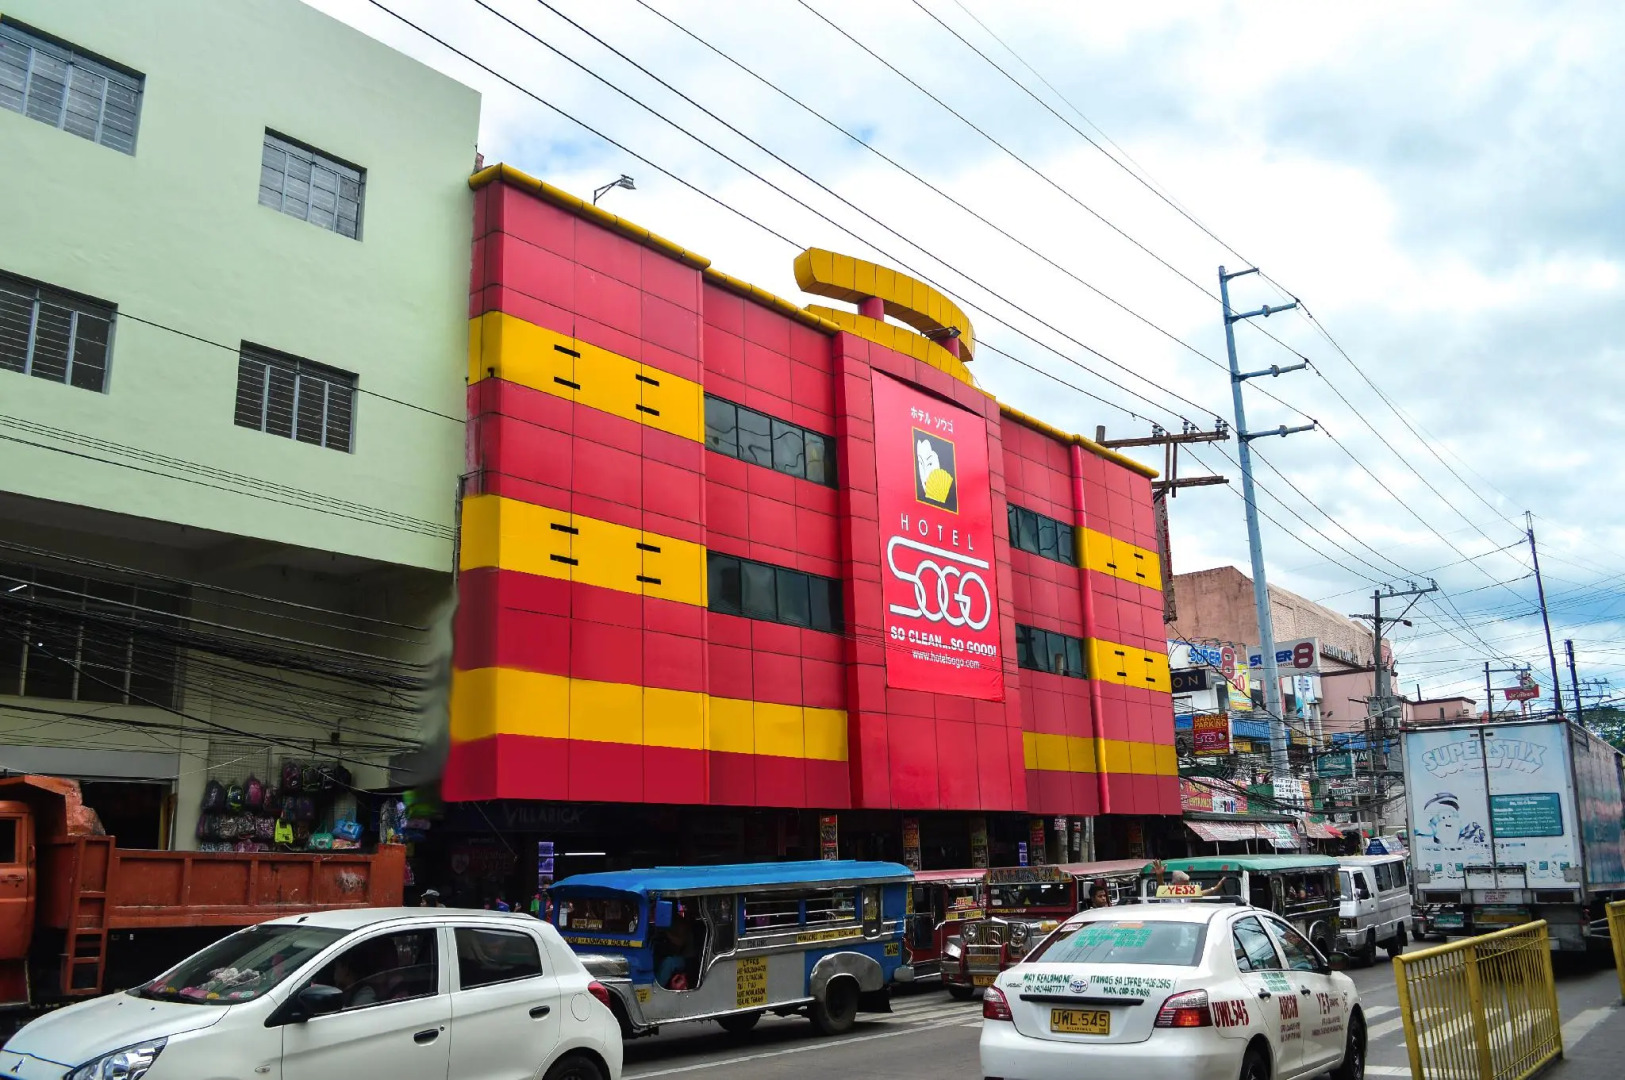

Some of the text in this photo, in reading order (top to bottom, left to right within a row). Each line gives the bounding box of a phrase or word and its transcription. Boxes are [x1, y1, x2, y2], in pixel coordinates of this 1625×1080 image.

[910, 405, 931, 425] ホテル
[900, 512, 974, 551] HOTEL
[886, 535, 992, 632] SOGO
[890, 625, 906, 641] SO
[966, 640, 997, 657] GOOD!
[1293, 642, 1315, 669] 8
[912, 650, 981, 670] www.hotelsogo.com
[1189, 646, 1235, 680] SUPER 8
[1421, 739, 1548, 774] SUPERSTIX
[1115, 976, 1123, 986] SA
[1211, 999, 1250, 1028] UWL545
